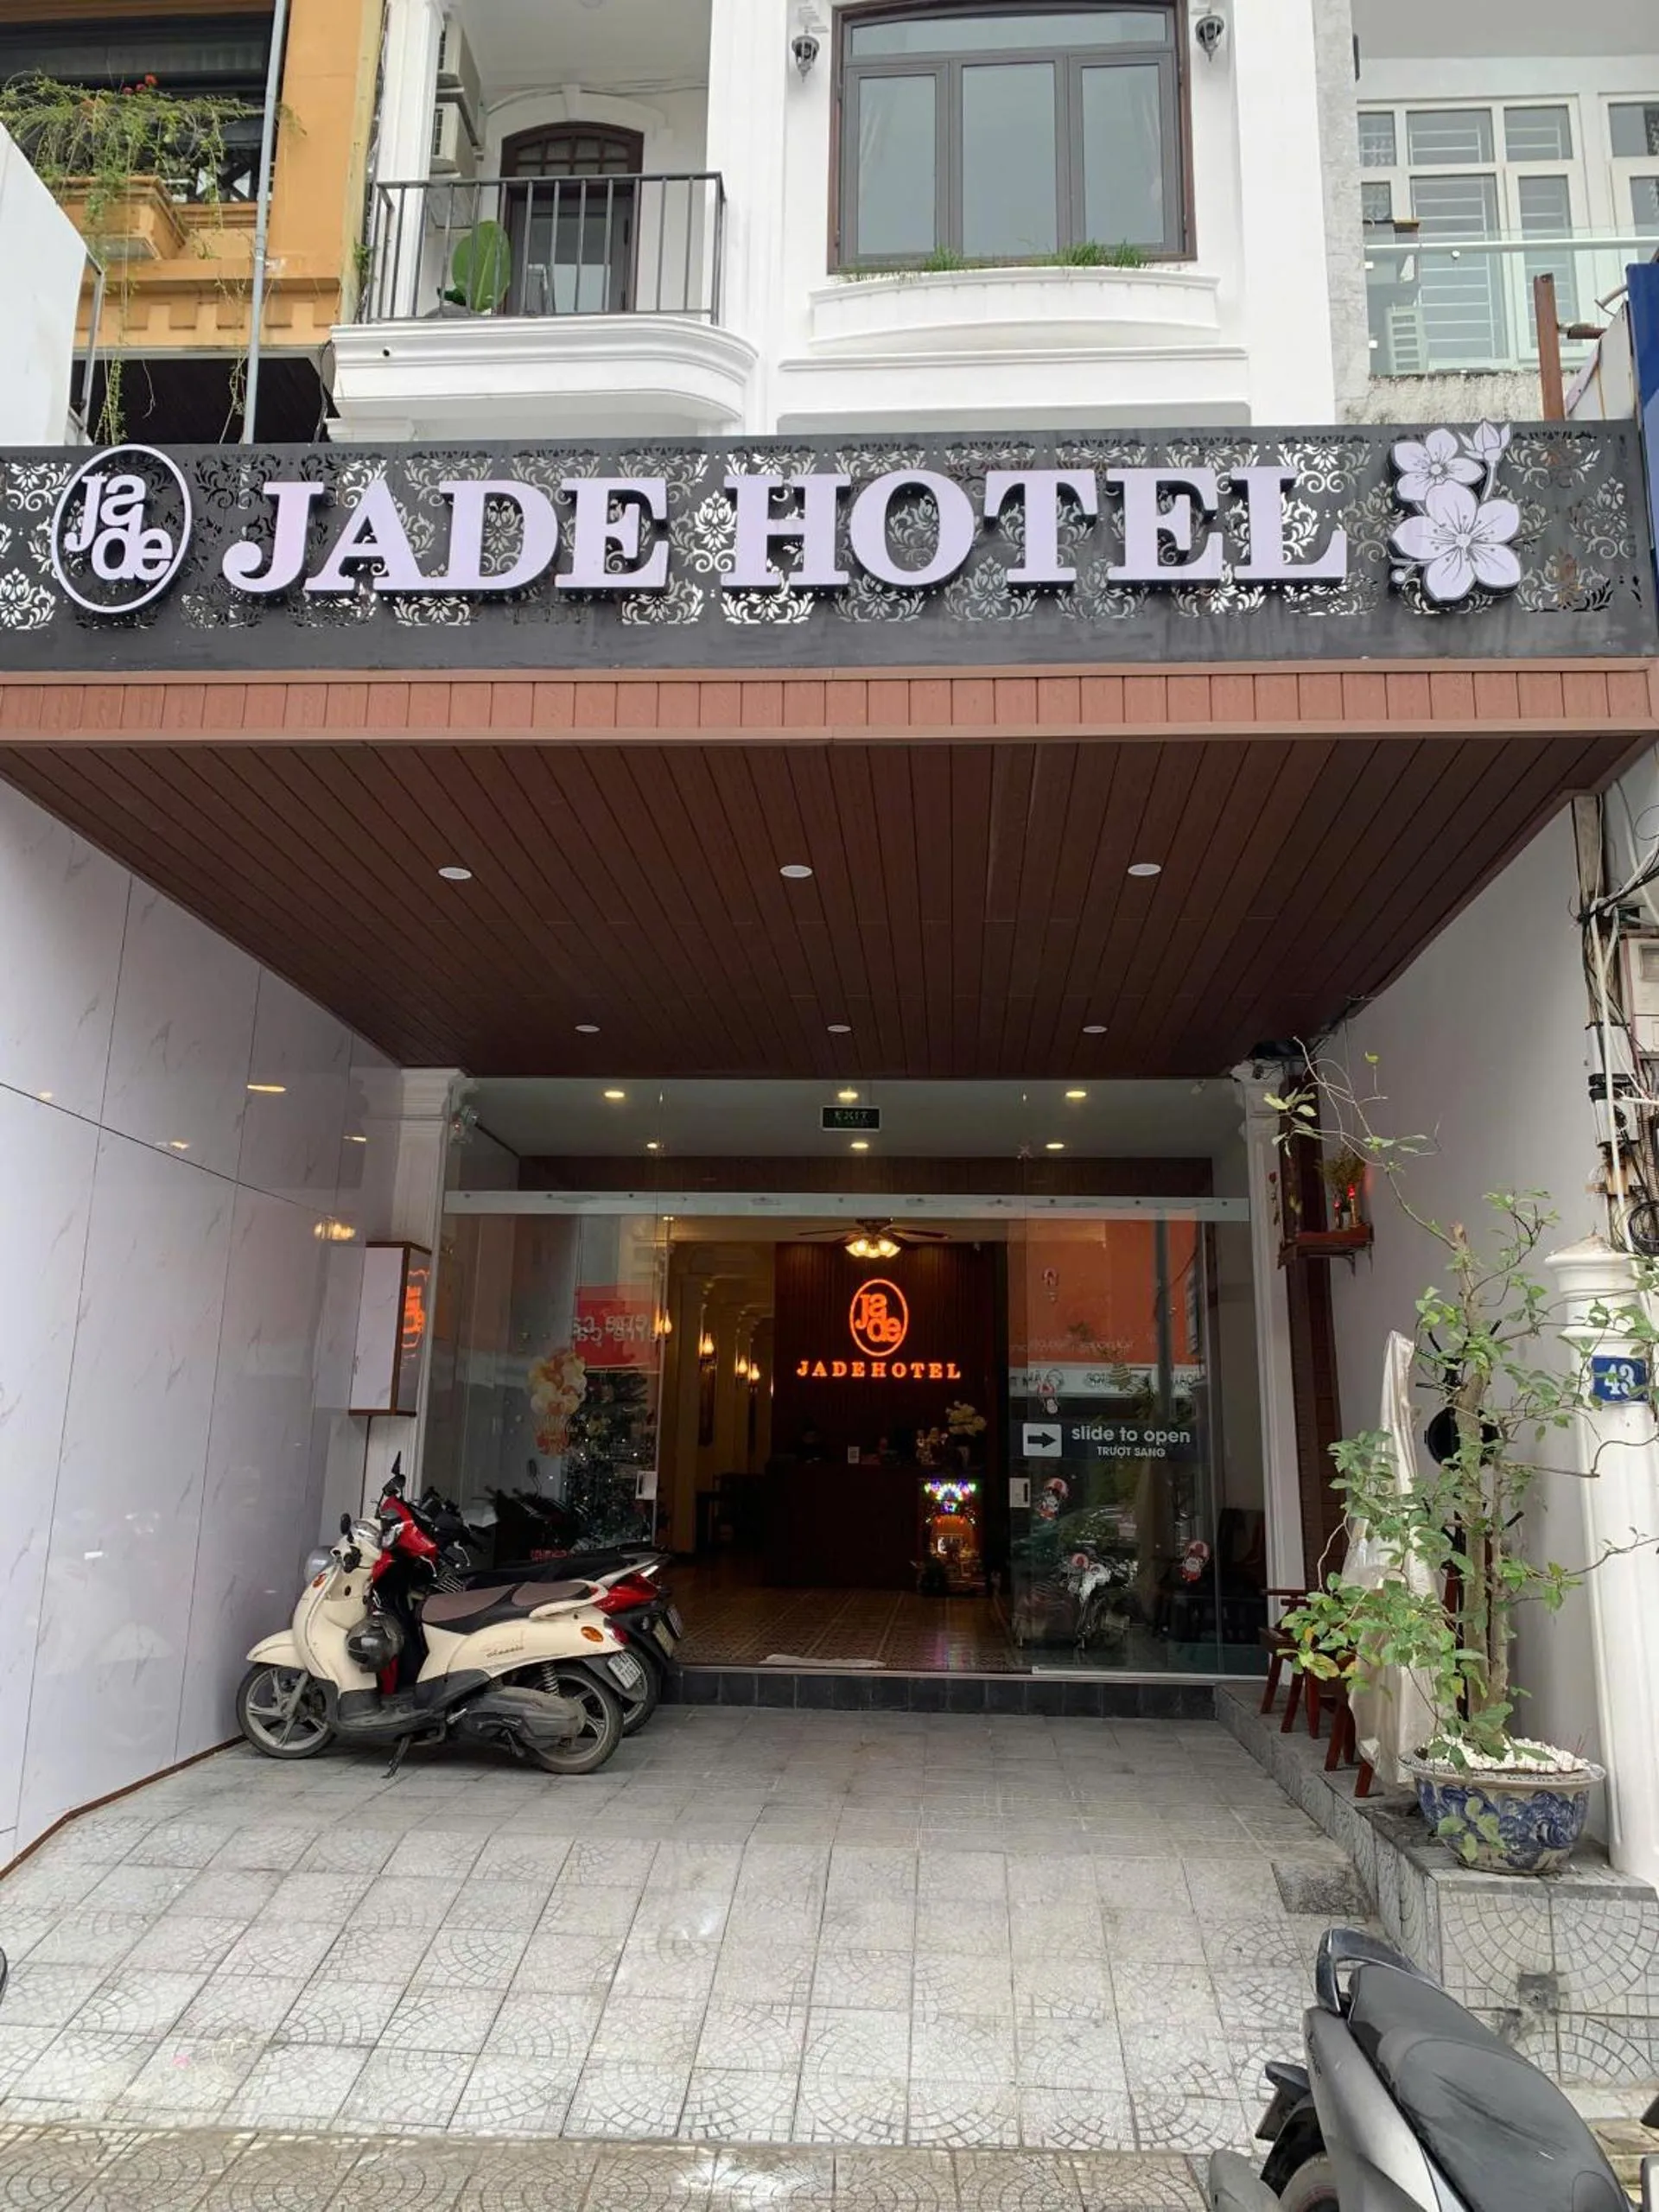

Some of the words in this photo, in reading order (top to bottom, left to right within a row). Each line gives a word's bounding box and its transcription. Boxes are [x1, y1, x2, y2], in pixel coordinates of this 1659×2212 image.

[221, 478, 671, 593] JADE
[721, 465, 1349, 589] HOTEL
[1604, 1363, 1636, 1396] 43
[1071, 1426, 1115, 1441] slide
[1120, 1426, 1138, 1442] to
[1144, 1429, 1191, 1446] open
[1134, 1447, 1166, 1458] SANG
